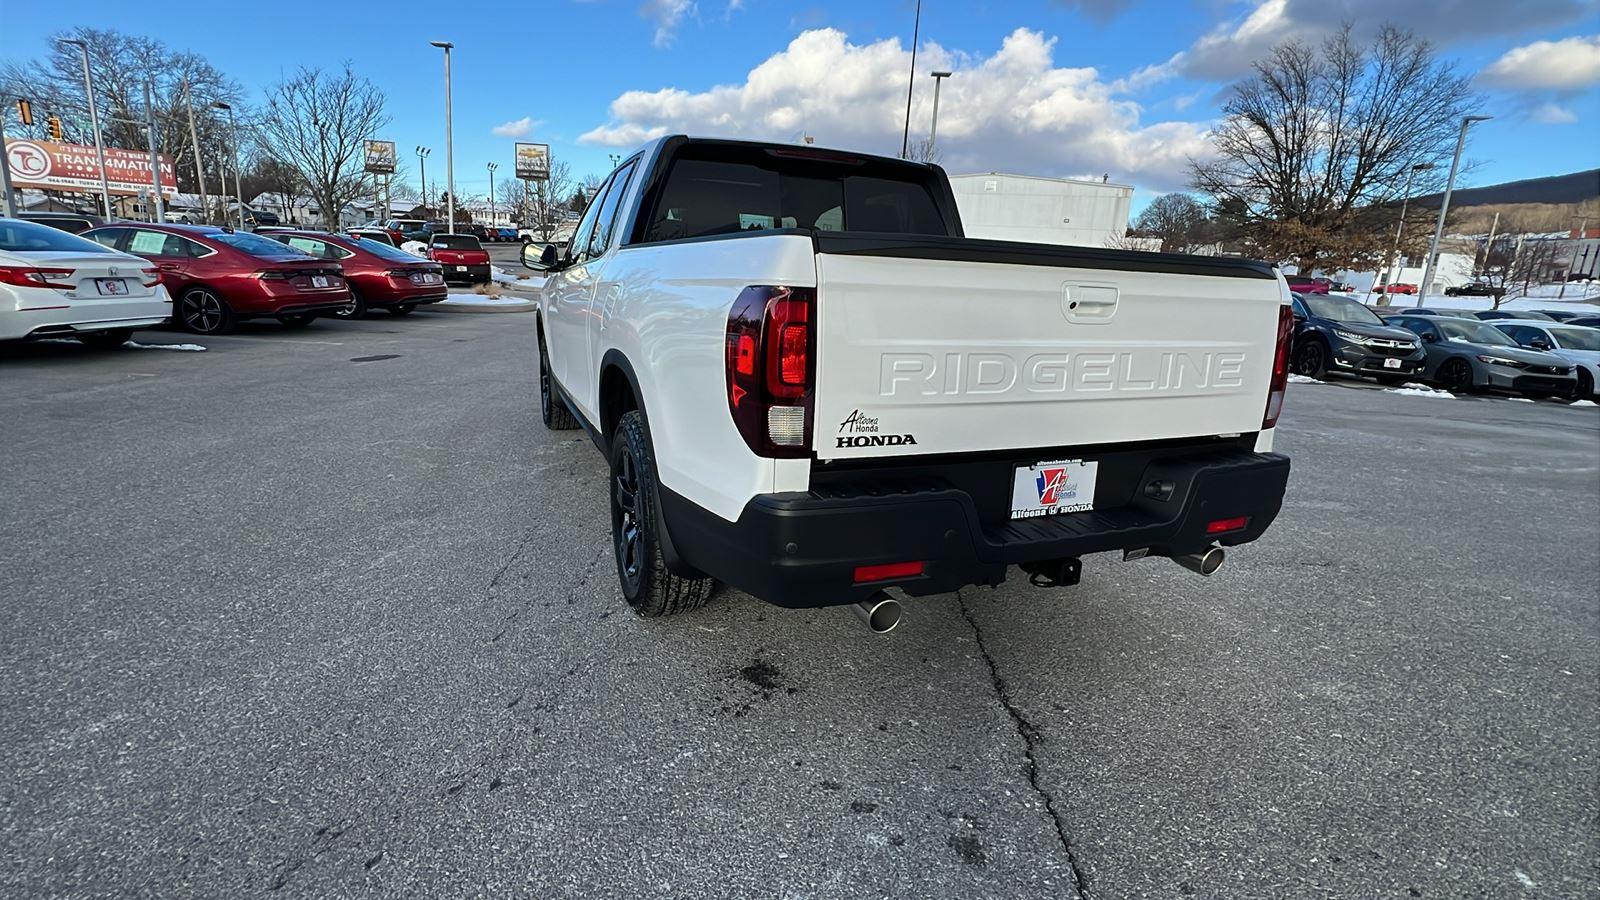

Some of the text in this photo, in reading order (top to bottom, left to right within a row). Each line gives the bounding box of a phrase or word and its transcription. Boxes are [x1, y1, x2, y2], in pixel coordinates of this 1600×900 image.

[879, 351, 1246, 397] RIDGELINE
[838, 408, 879, 433] Altoona
[856, 425, 879, 433] Honda
[835, 434, 918, 449] HONDA
[1055, 490, 1077, 500] Honda
[1011, 503, 1094, 520] Altoona HONDA
